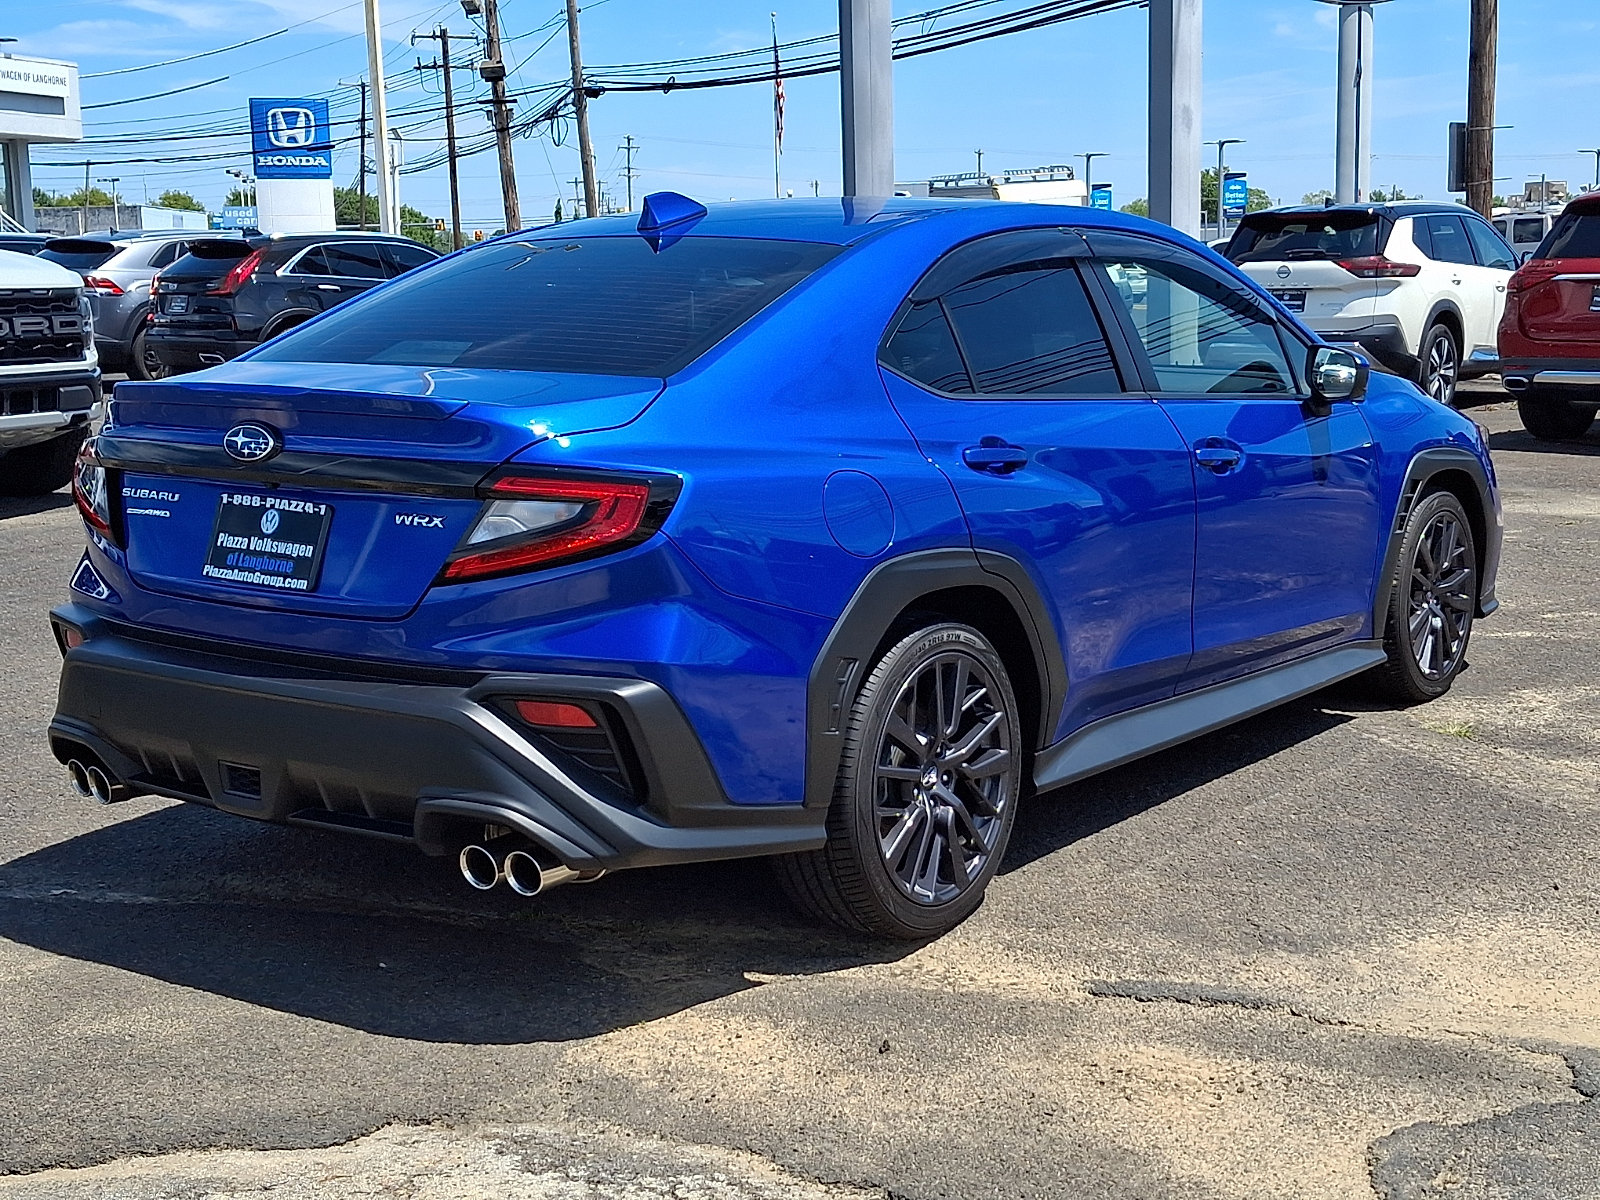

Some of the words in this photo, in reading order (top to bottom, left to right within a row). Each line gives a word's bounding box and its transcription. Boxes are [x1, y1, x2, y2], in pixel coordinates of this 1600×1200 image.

[0, 70, 22, 81] WAGEN
[23, 72, 31, 82] OF
[32, 73, 67, 87] LANGHORNE
[257, 155, 329, 167] HONDA
[224, 208, 253, 217] used
[236, 217, 258, 225] car
[121, 487, 181, 502] SUBARU
[220, 493, 327, 516] 1-888-PIAZZA-1
[395, 513, 447, 529] WRX
[216, 532, 248, 550] Piazza
[249, 536, 314, 557] Volkswagen
[226, 552, 238, 566] of
[238, 553, 294, 574] Langhorne
[202, 564, 308, 590] PiazzaAutoGroup.com
